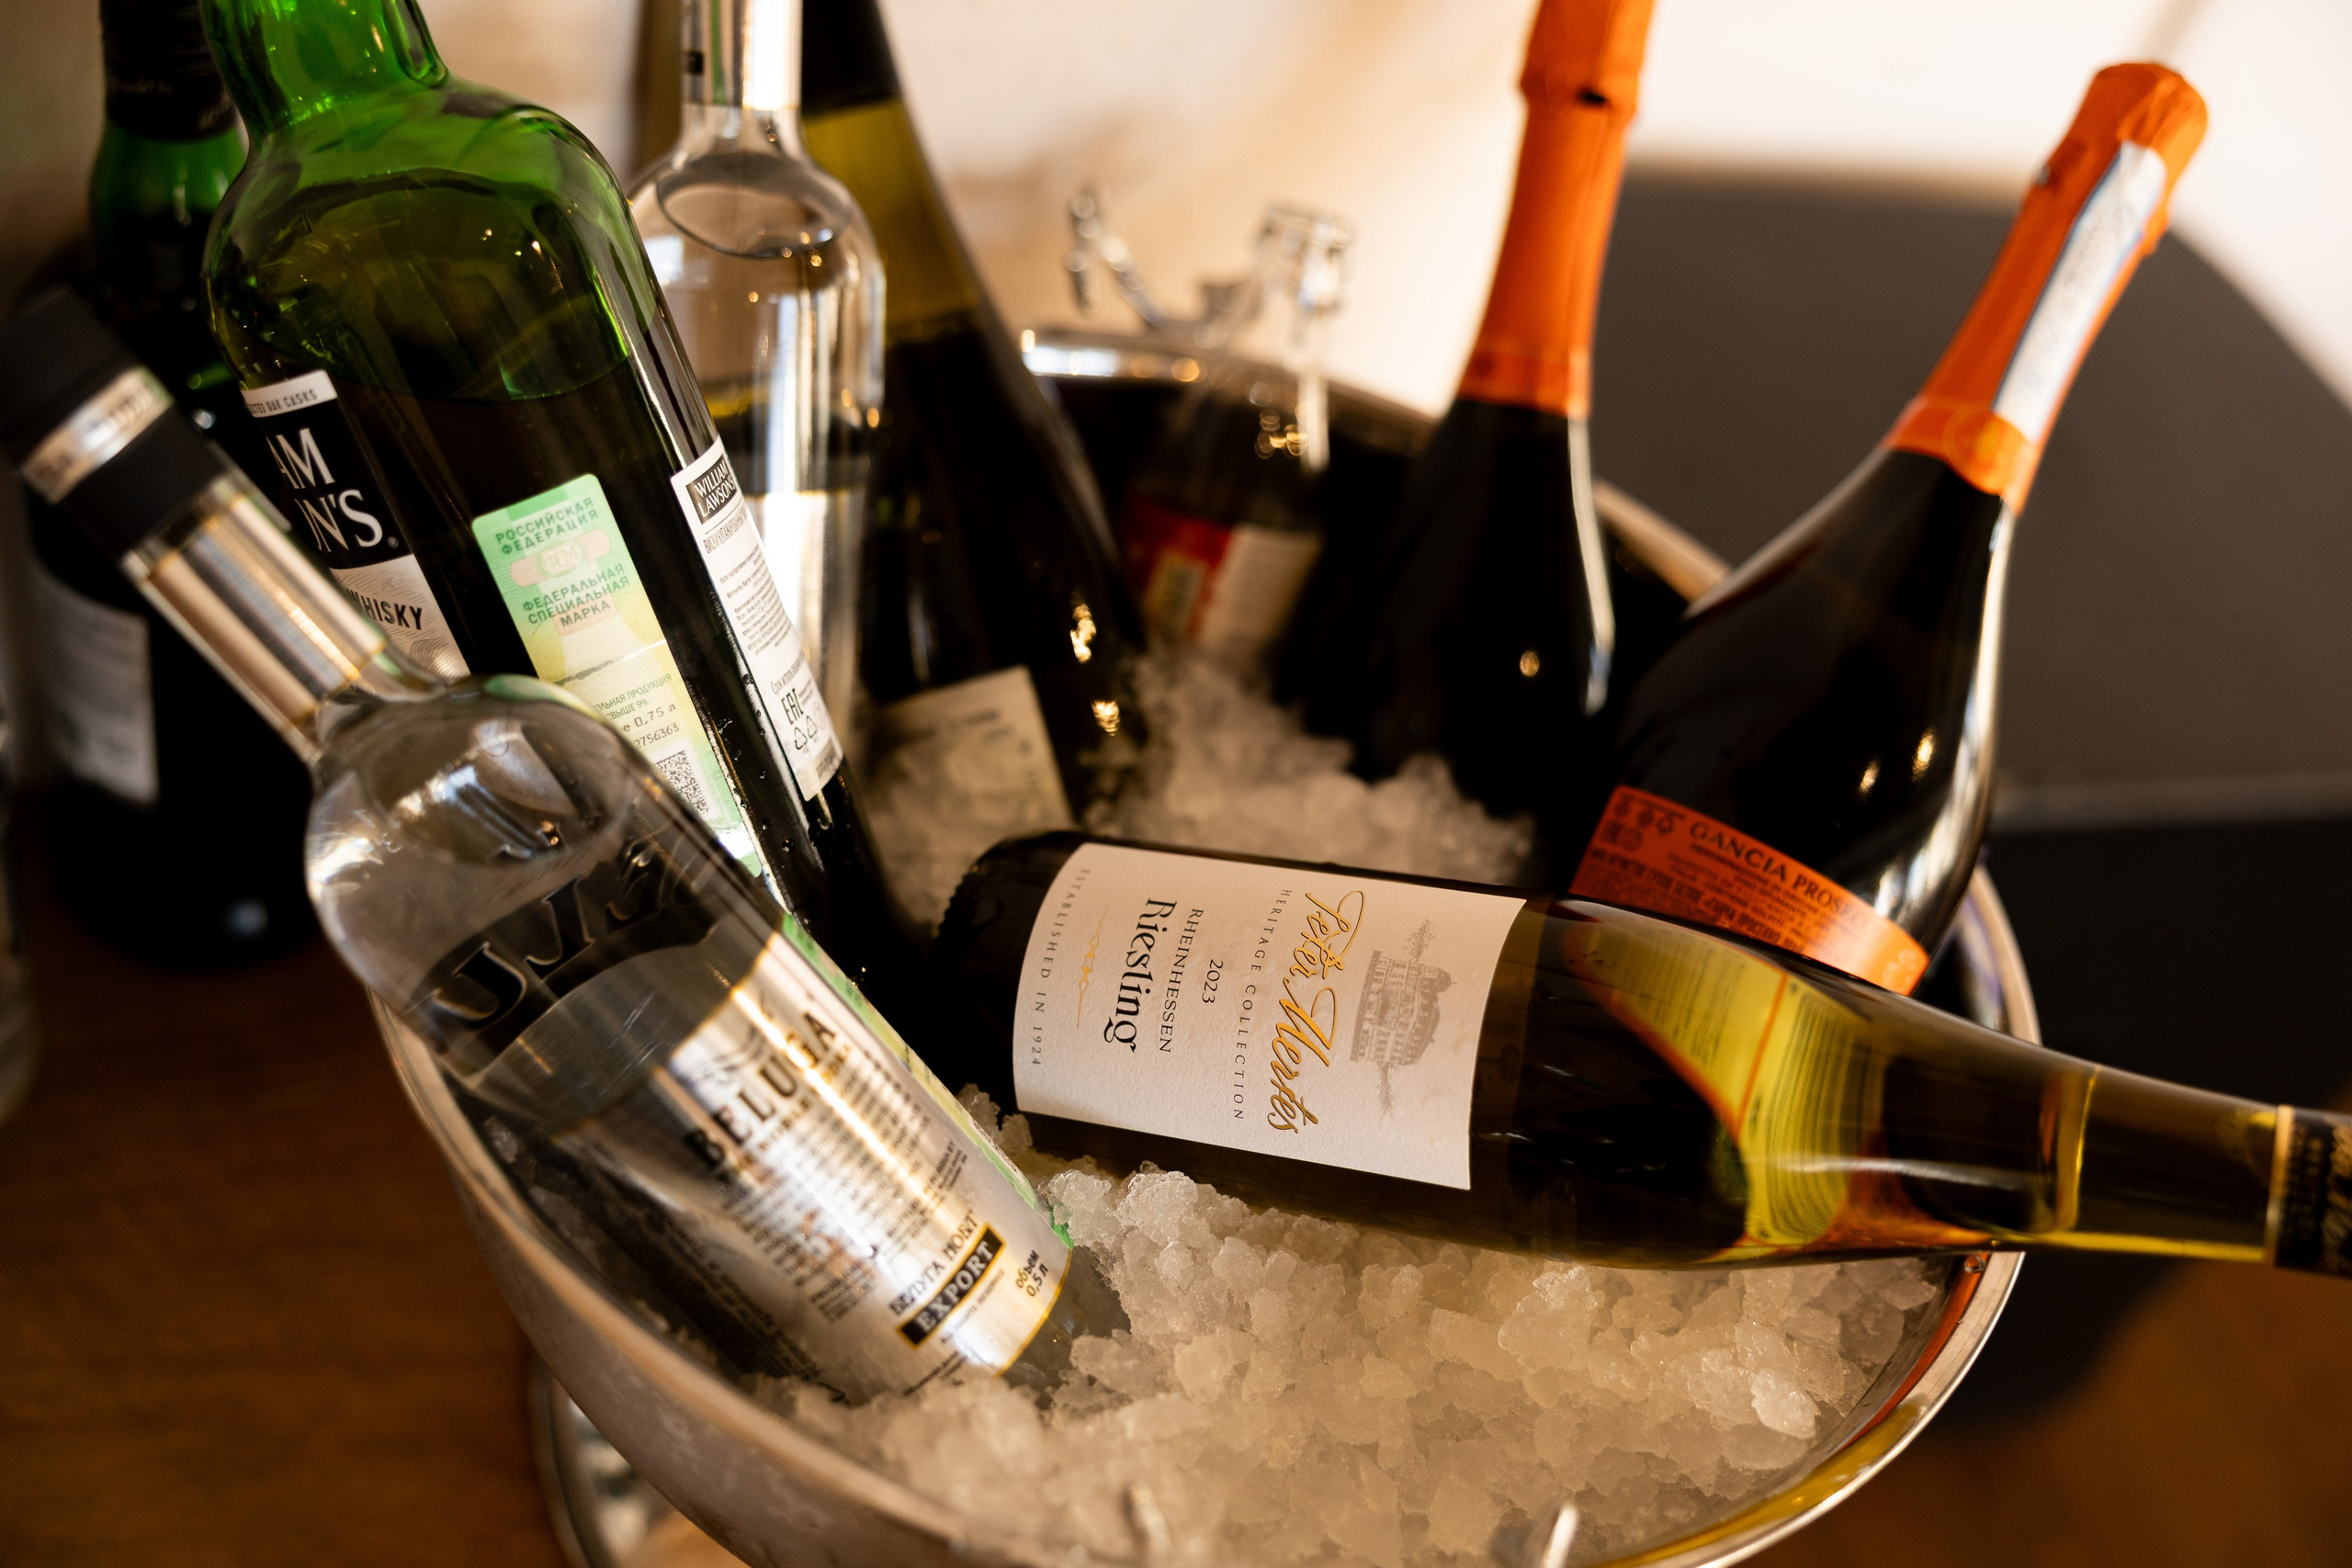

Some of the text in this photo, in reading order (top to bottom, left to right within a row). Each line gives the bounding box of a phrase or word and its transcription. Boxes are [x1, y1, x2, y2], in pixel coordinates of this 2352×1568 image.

[283, 389, 318, 409] CASKS
[695, 460, 729, 498] WILLIAM
[495, 497, 594, 544] РОССИЙСКАЯ
[502, 509, 599, 555] ФЕДЕРАЦИЯ
[523, 564, 625, 612] ФЕДЕРАЛЬНАЯ
[528, 576, 630, 625] СПЕЦИАЛЬНАЯ
[560, 601, 611, 627] МАРКА
[627, 673, 672, 700] ПРОДУКЦИЯ
[636, 698, 650, 711] 9%
[634, 706, 664, 728] 0,75
[1690, 821, 1788, 884] GANCIA
[1032, 869, 1091, 1066] ESTABLISHED IN 1924
[1103, 898, 1177, 1053] Riesling
[1159, 908, 1204, 1053] RHEINHESSEN
[1202, 959, 1224, 1004] 2023
[1233, 889, 1292, 1119] HERITAGE COLLECTION
[1267, 890, 1365, 1134] Peter Mertes
[685, 1011, 836, 1169] BELUGA
[915, 1239, 995, 1332] EXPORT
[1015, 1249, 1040, 1290] объем
[1026, 1274, 1045, 1298] 0,5
